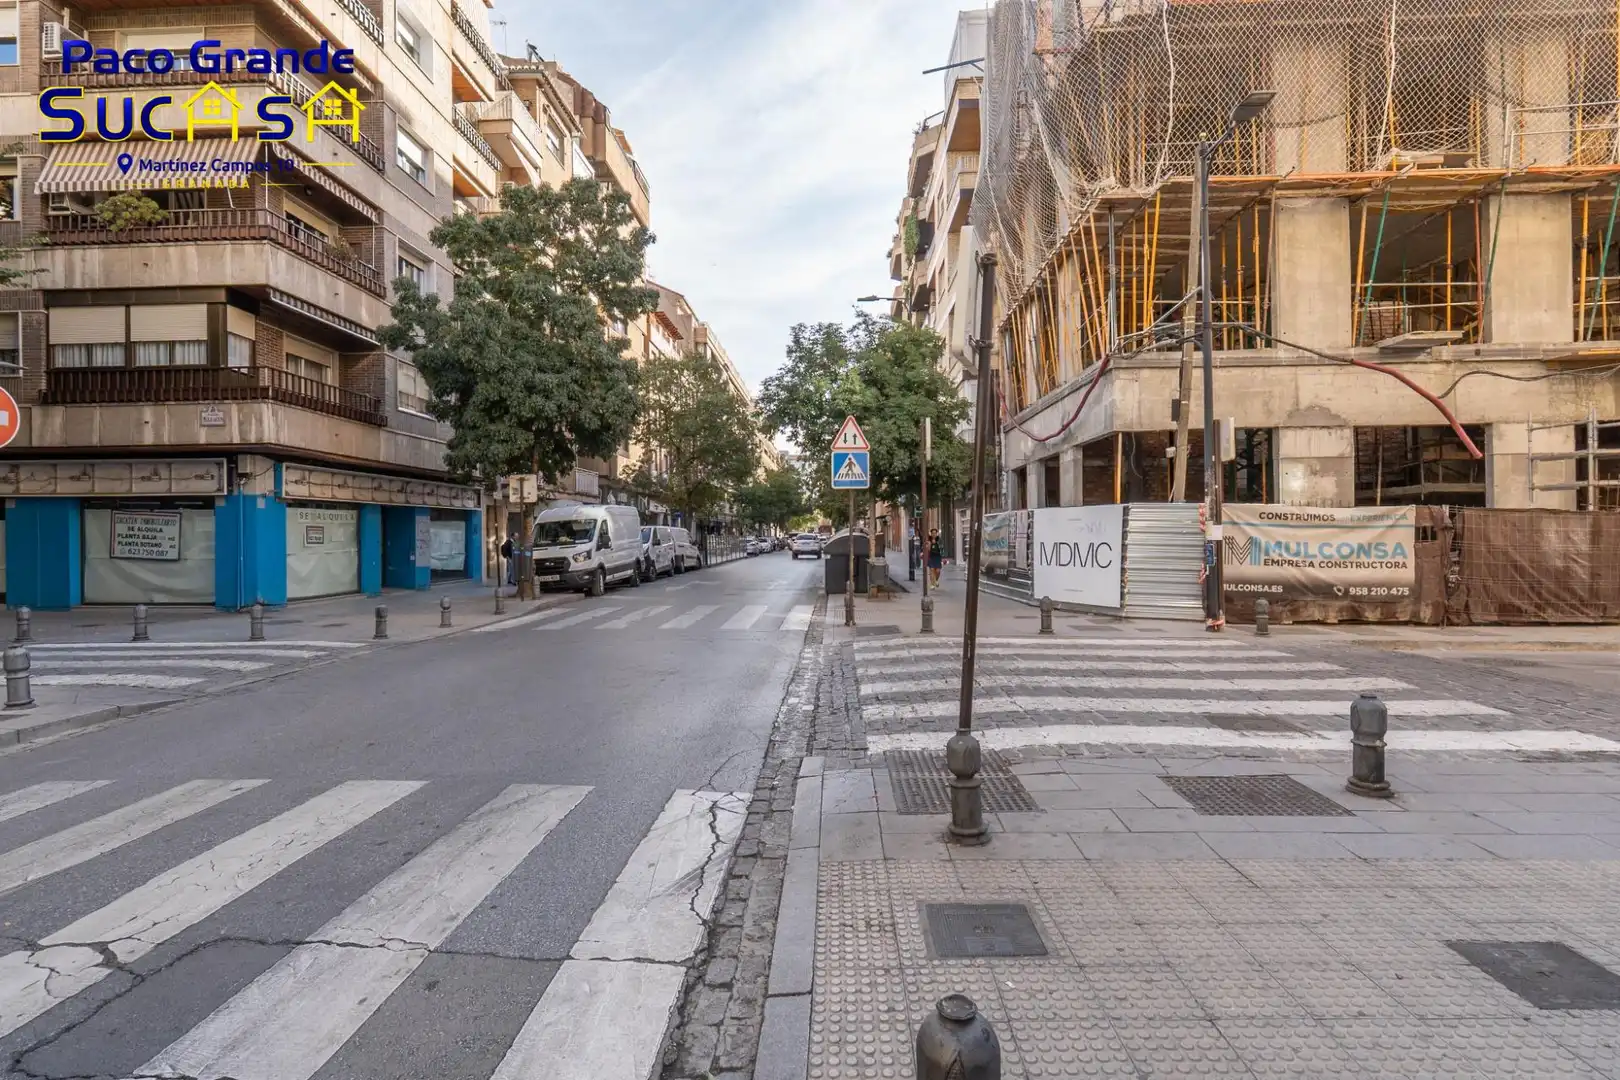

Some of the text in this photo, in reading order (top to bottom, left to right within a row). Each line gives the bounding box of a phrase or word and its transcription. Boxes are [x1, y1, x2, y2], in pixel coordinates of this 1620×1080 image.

[299, 512, 355, 521] SE ALQUILA
[1259, 511, 1336, 522] CONSTRUIMOS
[1040, 541, 1113, 569] MDMC
[1263, 540, 1408, 560] MULCONSA
[1263, 558, 1408, 569] EMPRESA CONSTRUCTORA
[1349, 587, 1410, 596] 958 210 475
